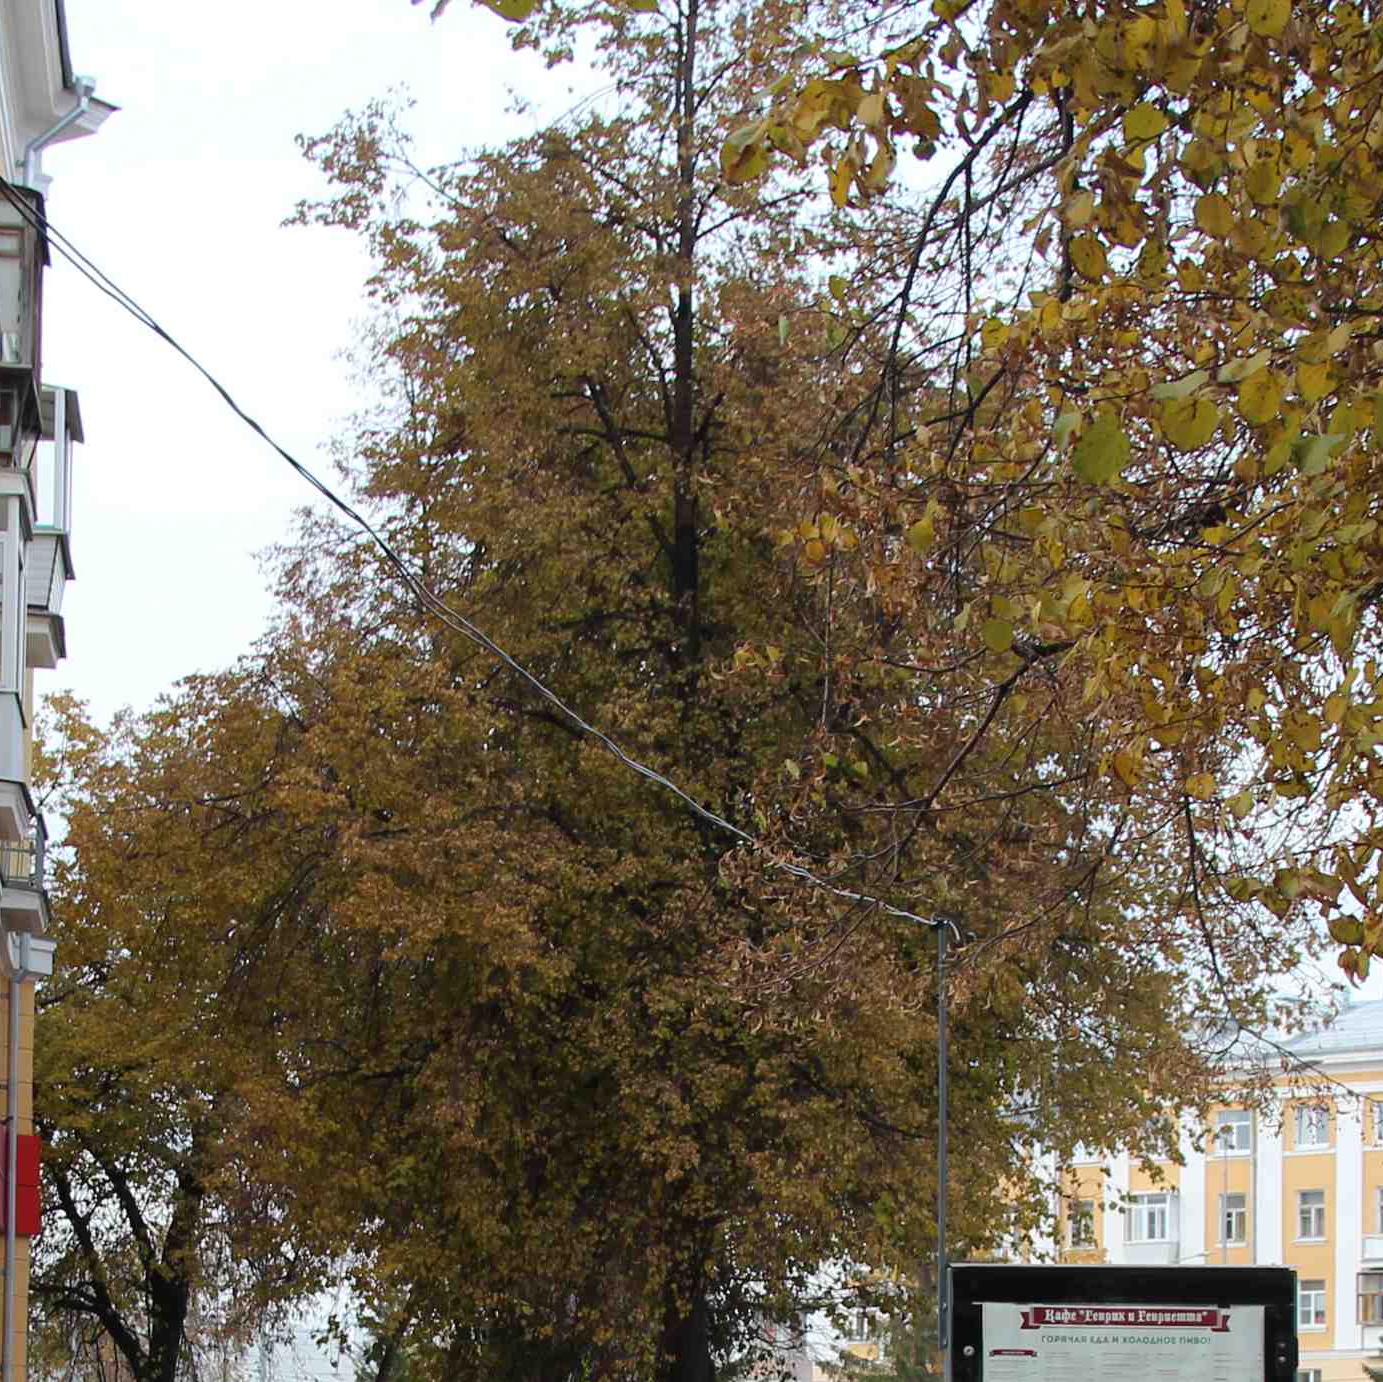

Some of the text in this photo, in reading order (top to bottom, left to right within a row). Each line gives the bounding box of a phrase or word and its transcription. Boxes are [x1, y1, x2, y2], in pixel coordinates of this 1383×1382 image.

[1044, 1308, 1077, 1323] Кафе
[1041, 1335, 1088, 1344] ГОРЯЧАЯ
[1090, 1335, 1110, 1345] ЕДА
[1121, 1335, 1177, 1345] ХОЛОДНОЕ
[1179, 1335, 1212, 1345] ПИВО!
